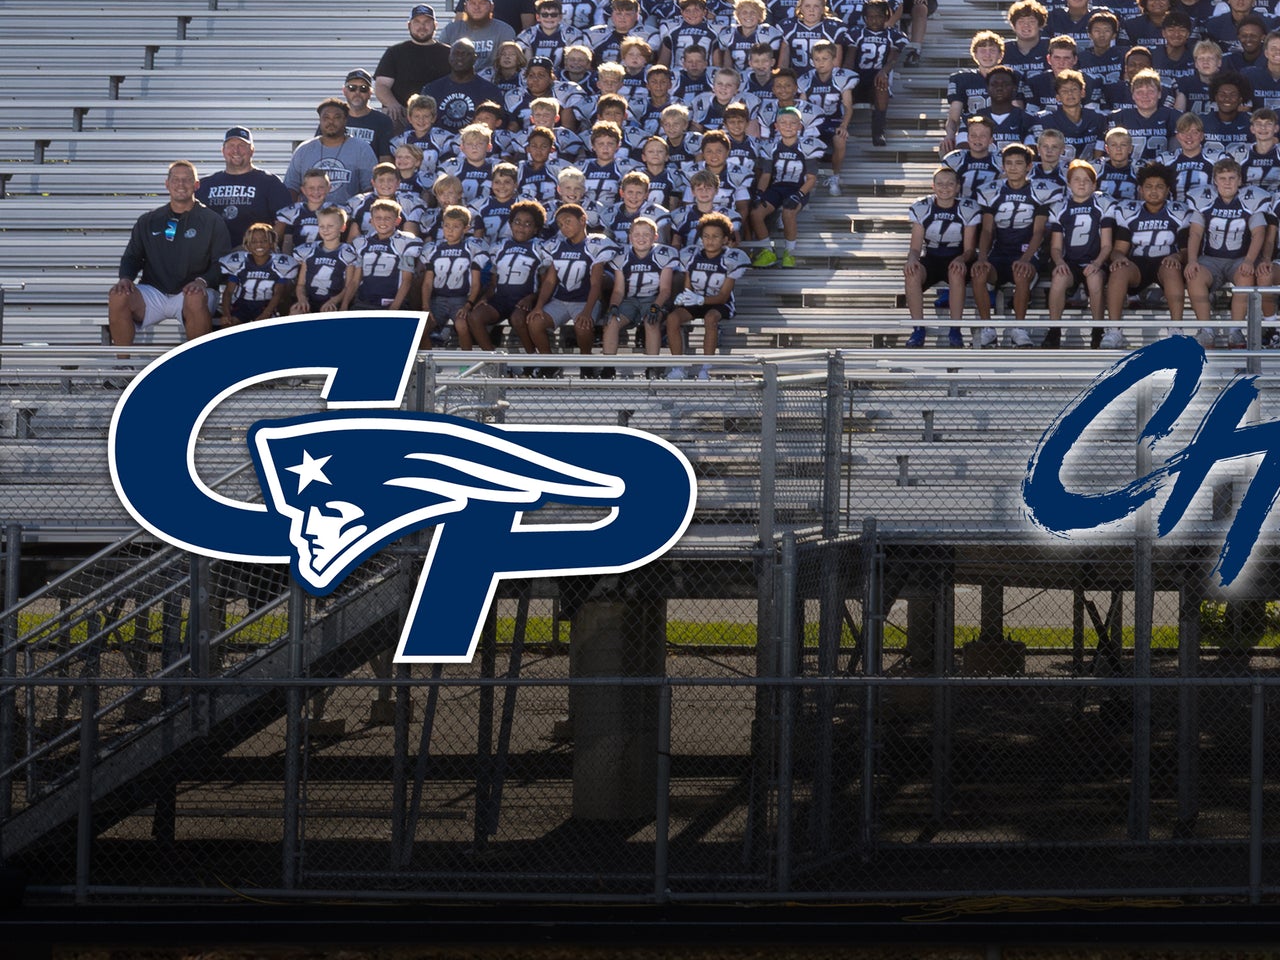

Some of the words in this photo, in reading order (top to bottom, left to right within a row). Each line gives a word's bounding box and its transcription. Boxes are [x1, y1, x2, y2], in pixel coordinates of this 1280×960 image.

[861, 44, 888, 69] 21
[439, 93, 465, 110] CHAMPLIN
[208, 185, 256, 198] REBELS
[209, 197, 252, 205] FOOTBALL
[934, 212, 954, 220] REBELS
[994, 203, 1034, 229] 22
[1212, 209, 1242, 218] REBELS
[1071, 214, 1092, 246] 2
[1138, 220, 1168, 230] REBELS
[315, 257, 336, 265] REBELS
[310, 266, 334, 295] 4
[433, 258, 470, 289] 88
[628, 272, 660, 297] 12
